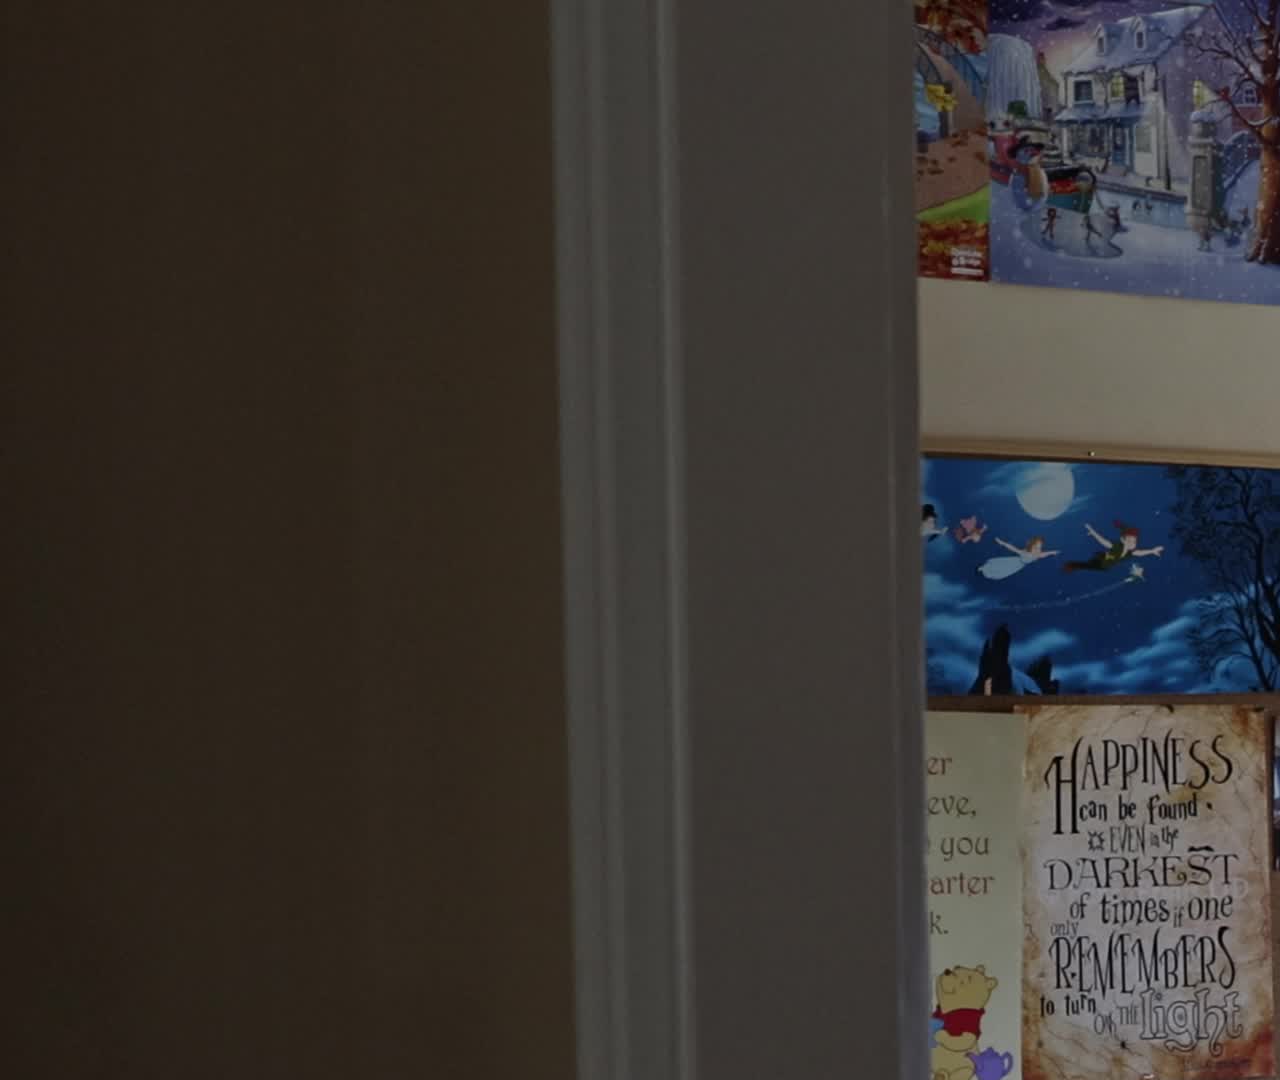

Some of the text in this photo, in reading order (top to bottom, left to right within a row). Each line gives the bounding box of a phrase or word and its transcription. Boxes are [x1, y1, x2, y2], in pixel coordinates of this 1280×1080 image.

[1044, 729, 1232, 834] HAPPINESS
[928, 796, 976, 819] eve,
[1079, 792, 1198, 824] can be found
[940, 837, 988, 862] you
[1109, 824, 1146, 855] EVEN
[929, 872, 995, 896] arter
[1043, 853, 1239, 891] DARKEST
[1070, 892, 1089, 919] of
[1101, 895, 1169, 926] times
[1188, 896, 1233, 921] one
[1051, 920, 1079, 939] only
[1049, 926, 1235, 1000] REMEMBERS
[1040, 995, 1055, 1017] to
[1065, 994, 1097, 1017] turn
[1139, 987, 1243, 1057] light
